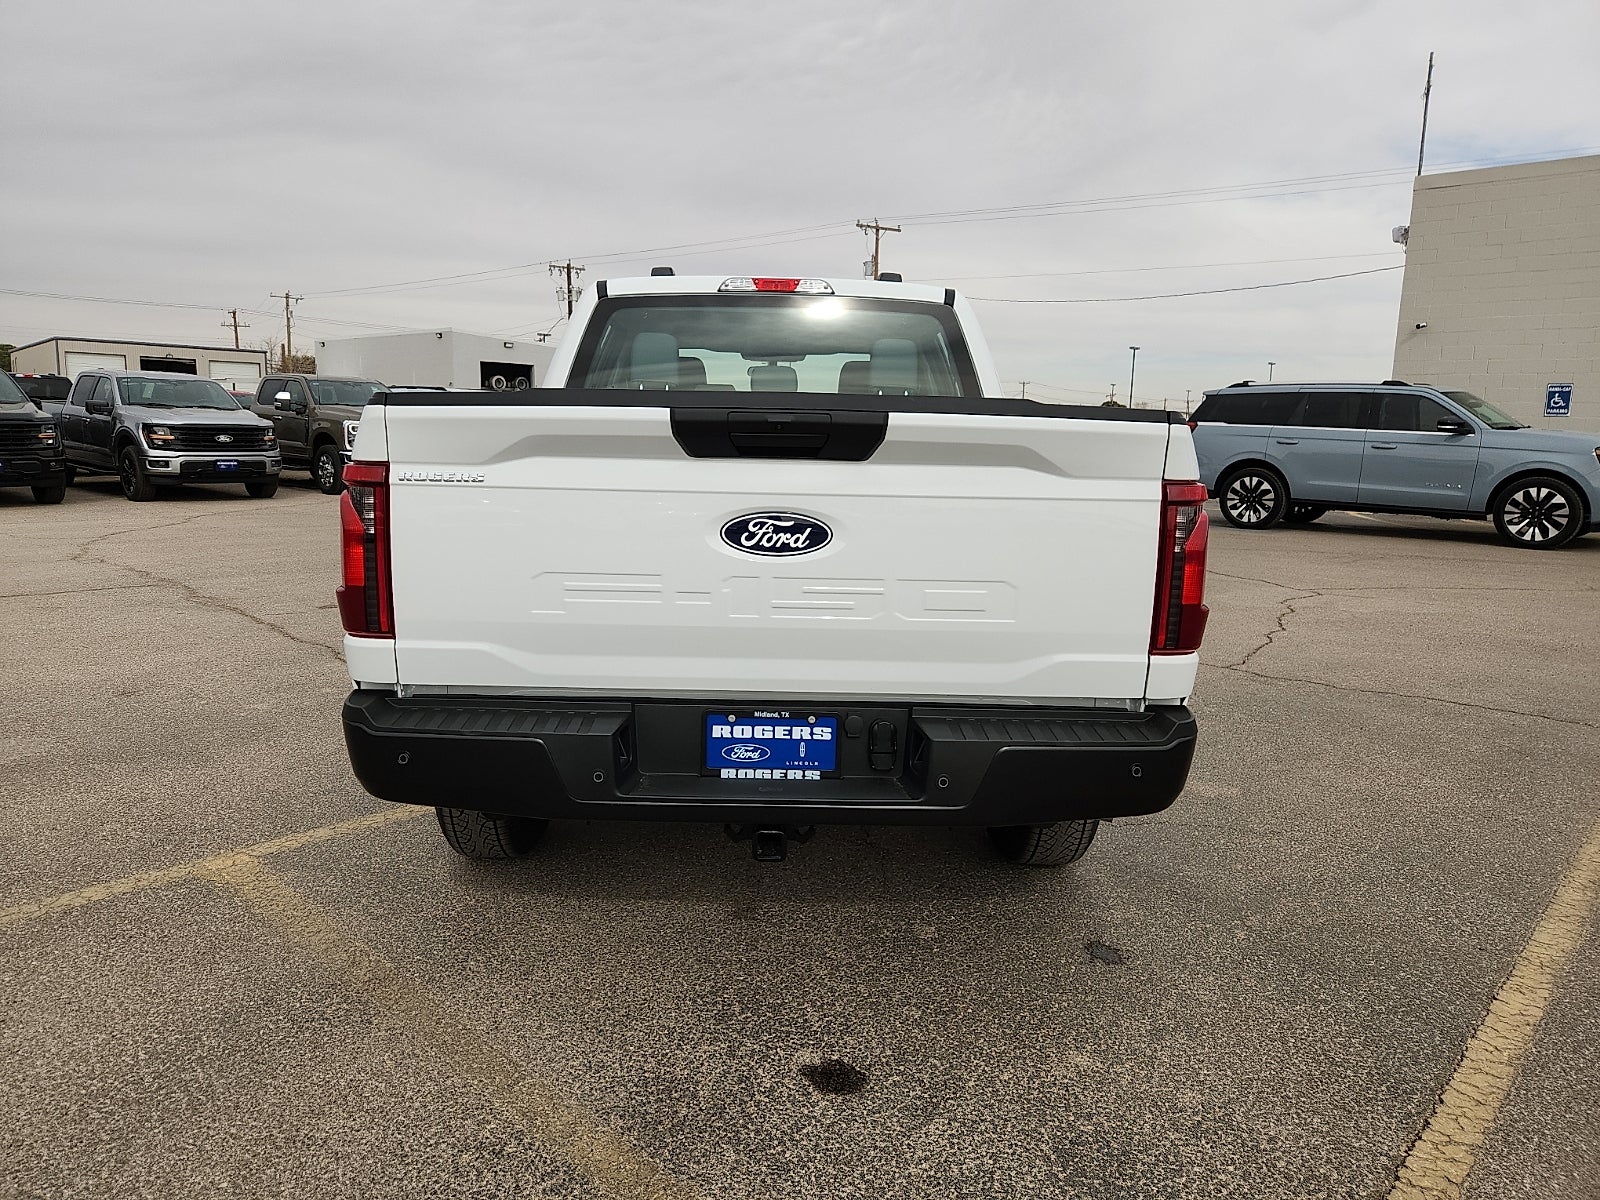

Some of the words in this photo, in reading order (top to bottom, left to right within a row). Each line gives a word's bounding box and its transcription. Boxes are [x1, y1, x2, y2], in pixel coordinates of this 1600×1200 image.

[398, 472, 485, 483] ROGERS
[740, 518, 813, 549] Ford
[531, 571, 1018, 622] F-150
[754, 711, 780, 719] Midland,
[712, 725, 832, 741] ROGERS
[731, 745, 761, 759] Ford
[721, 768, 821, 780] ROGERS
